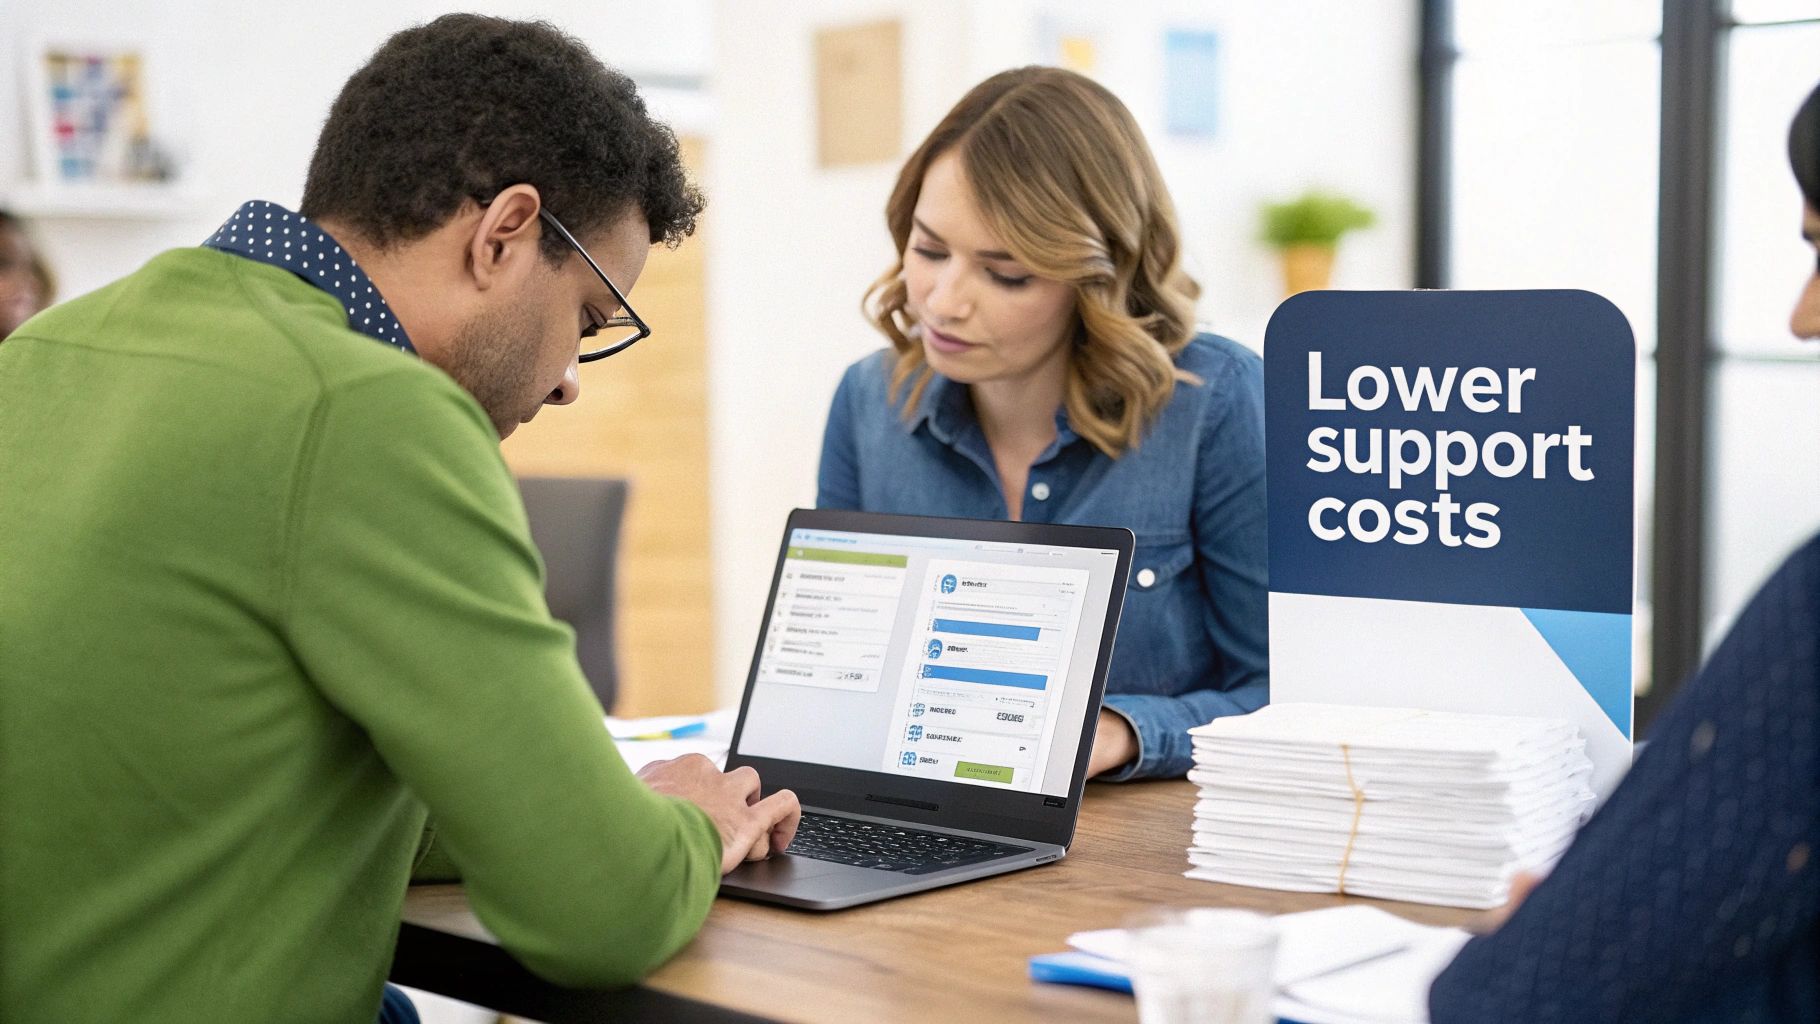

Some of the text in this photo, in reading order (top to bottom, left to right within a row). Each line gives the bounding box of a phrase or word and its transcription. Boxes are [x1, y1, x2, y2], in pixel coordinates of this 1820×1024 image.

[1308, 351, 1537, 414] Lower
[1306, 425, 1595, 491] support
[1308, 493, 1501, 549] costs
